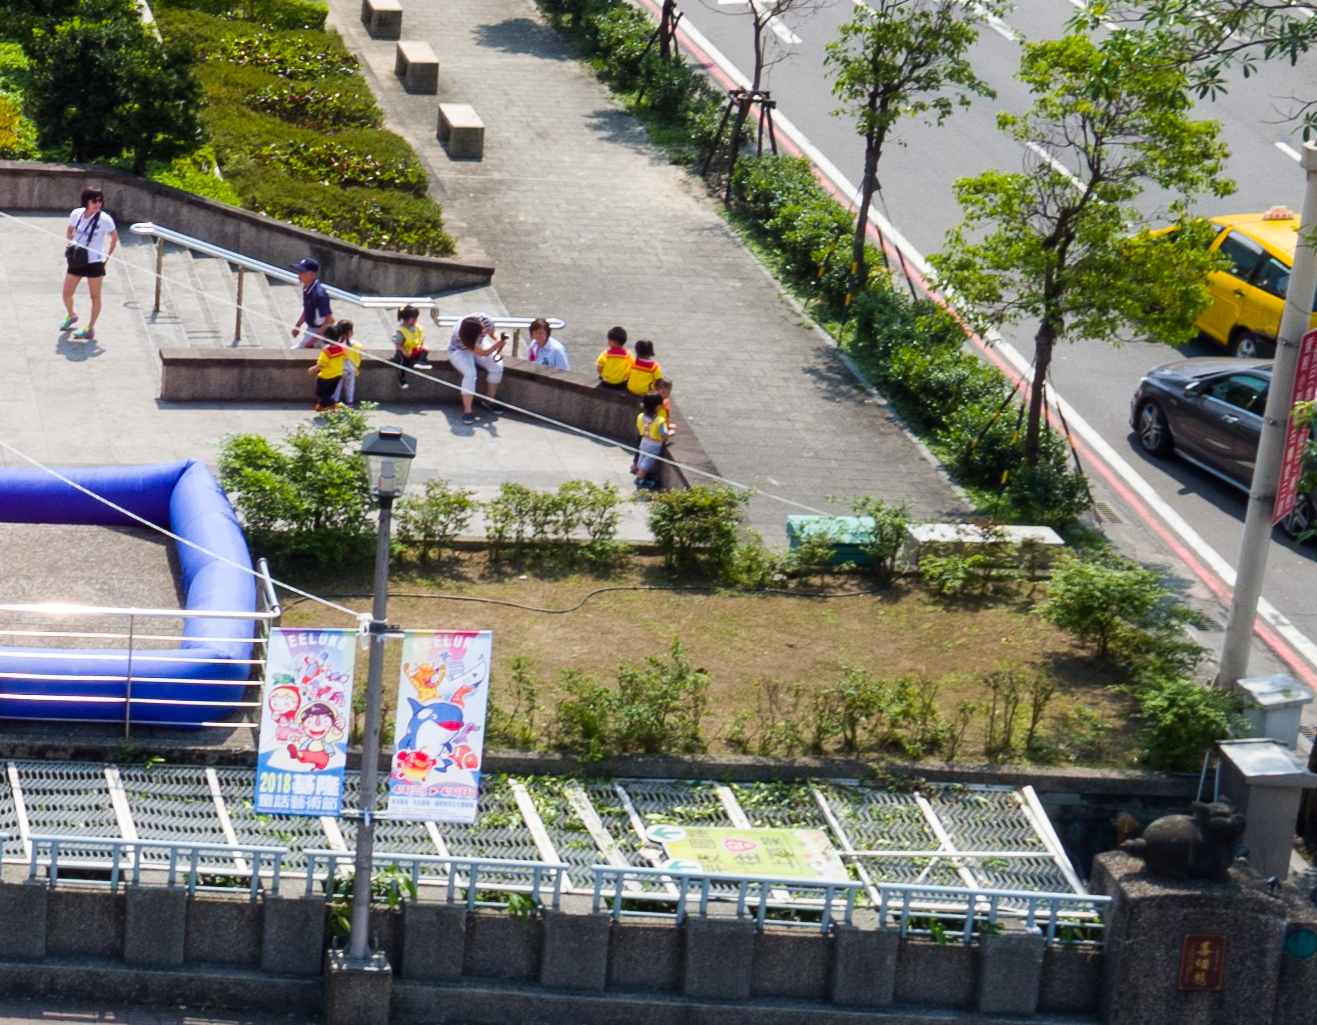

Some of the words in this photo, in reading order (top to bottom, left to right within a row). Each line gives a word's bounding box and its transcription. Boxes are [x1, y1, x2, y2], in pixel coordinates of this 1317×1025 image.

[257, 794, 339, 810] 童話藝術節
